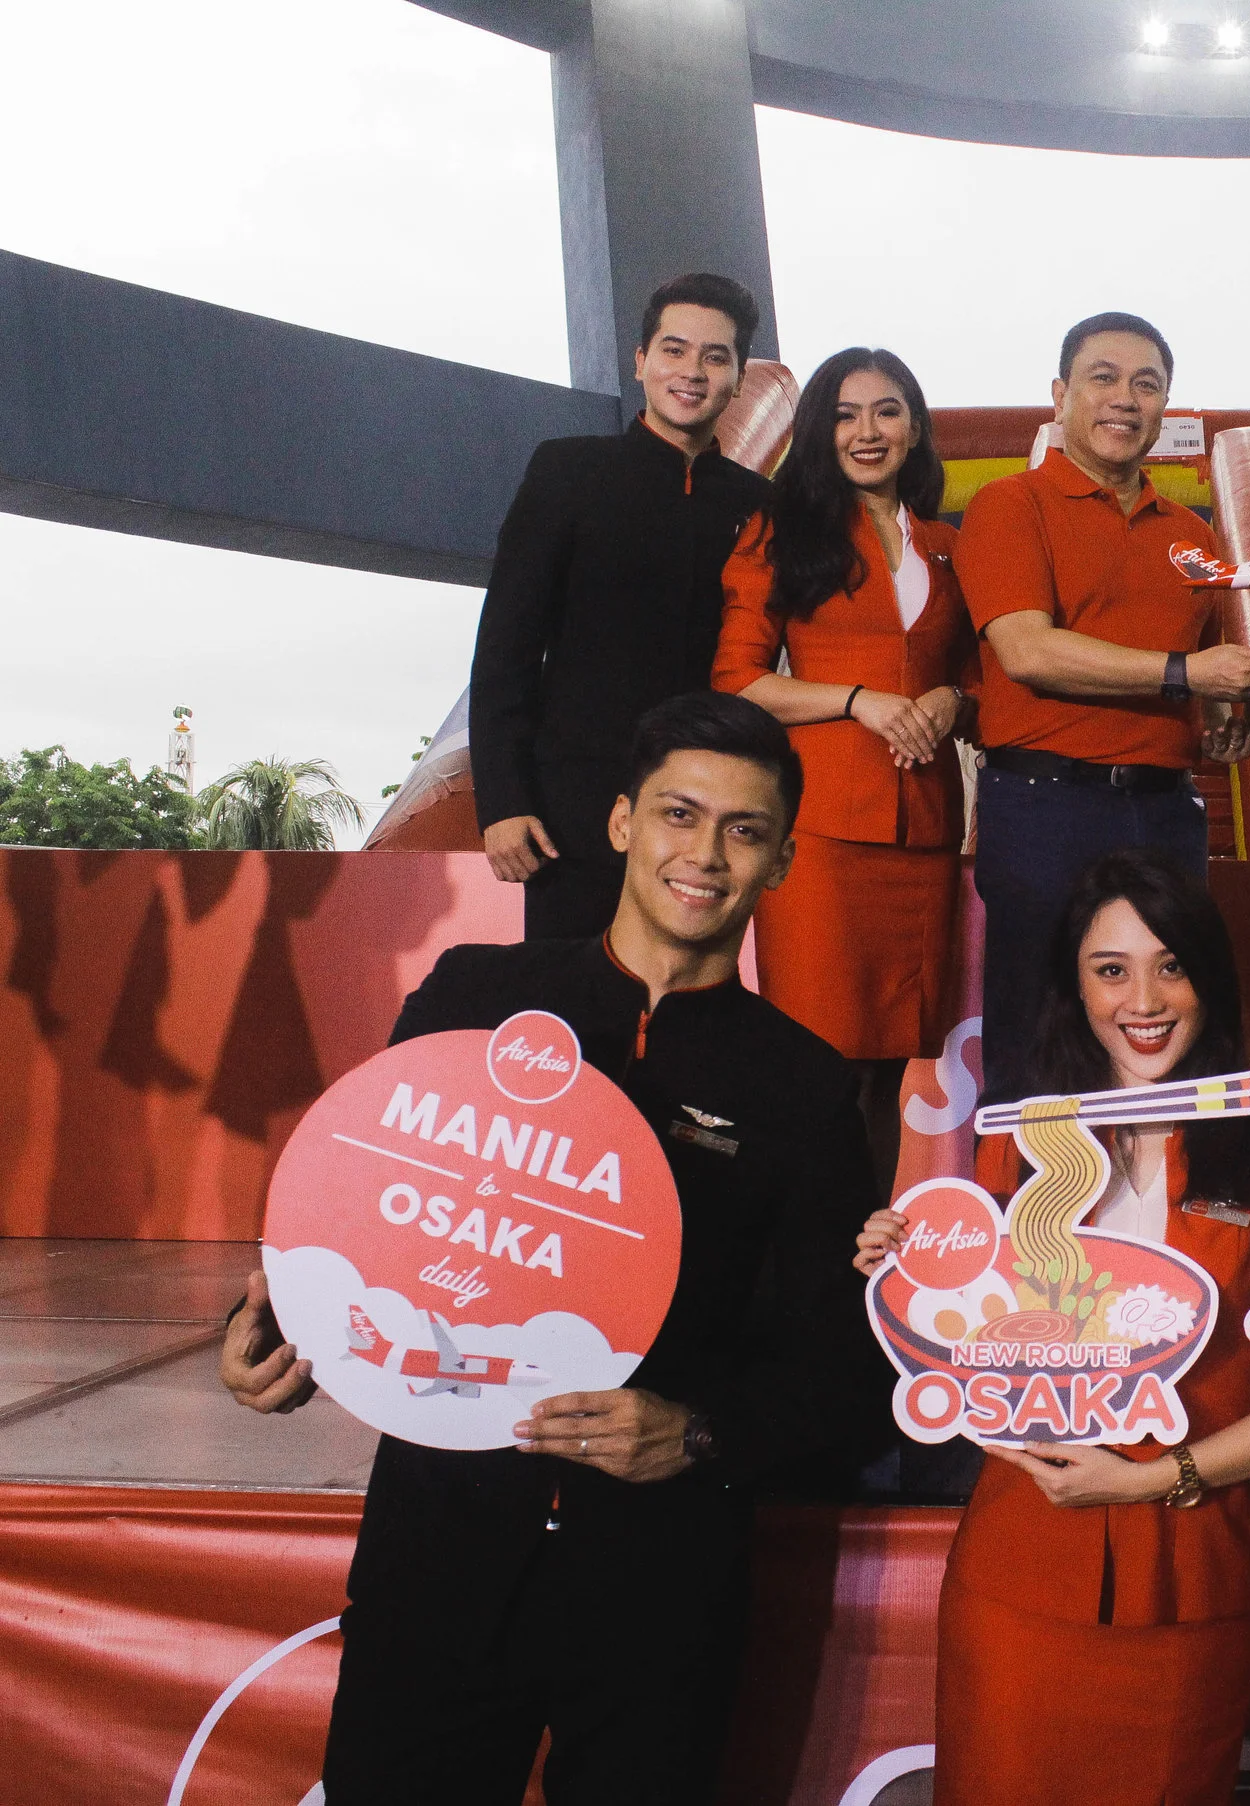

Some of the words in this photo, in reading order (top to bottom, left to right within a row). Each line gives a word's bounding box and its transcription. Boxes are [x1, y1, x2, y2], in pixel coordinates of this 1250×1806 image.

[496, 1036, 571, 1074] AirAsia
[379, 1082, 623, 1205] MANILA
[475, 1173, 500, 1197] to
[379, 1183, 564, 1278] OSAKA
[901, 1219, 990, 1259] AirAsia
[418, 1256, 490, 1308] daily
[952, 1343, 1021, 1367] NEW
[1025, 1343, 1131, 1367] ROUTE!
[904, 1372, 1178, 1433] OSAKA
